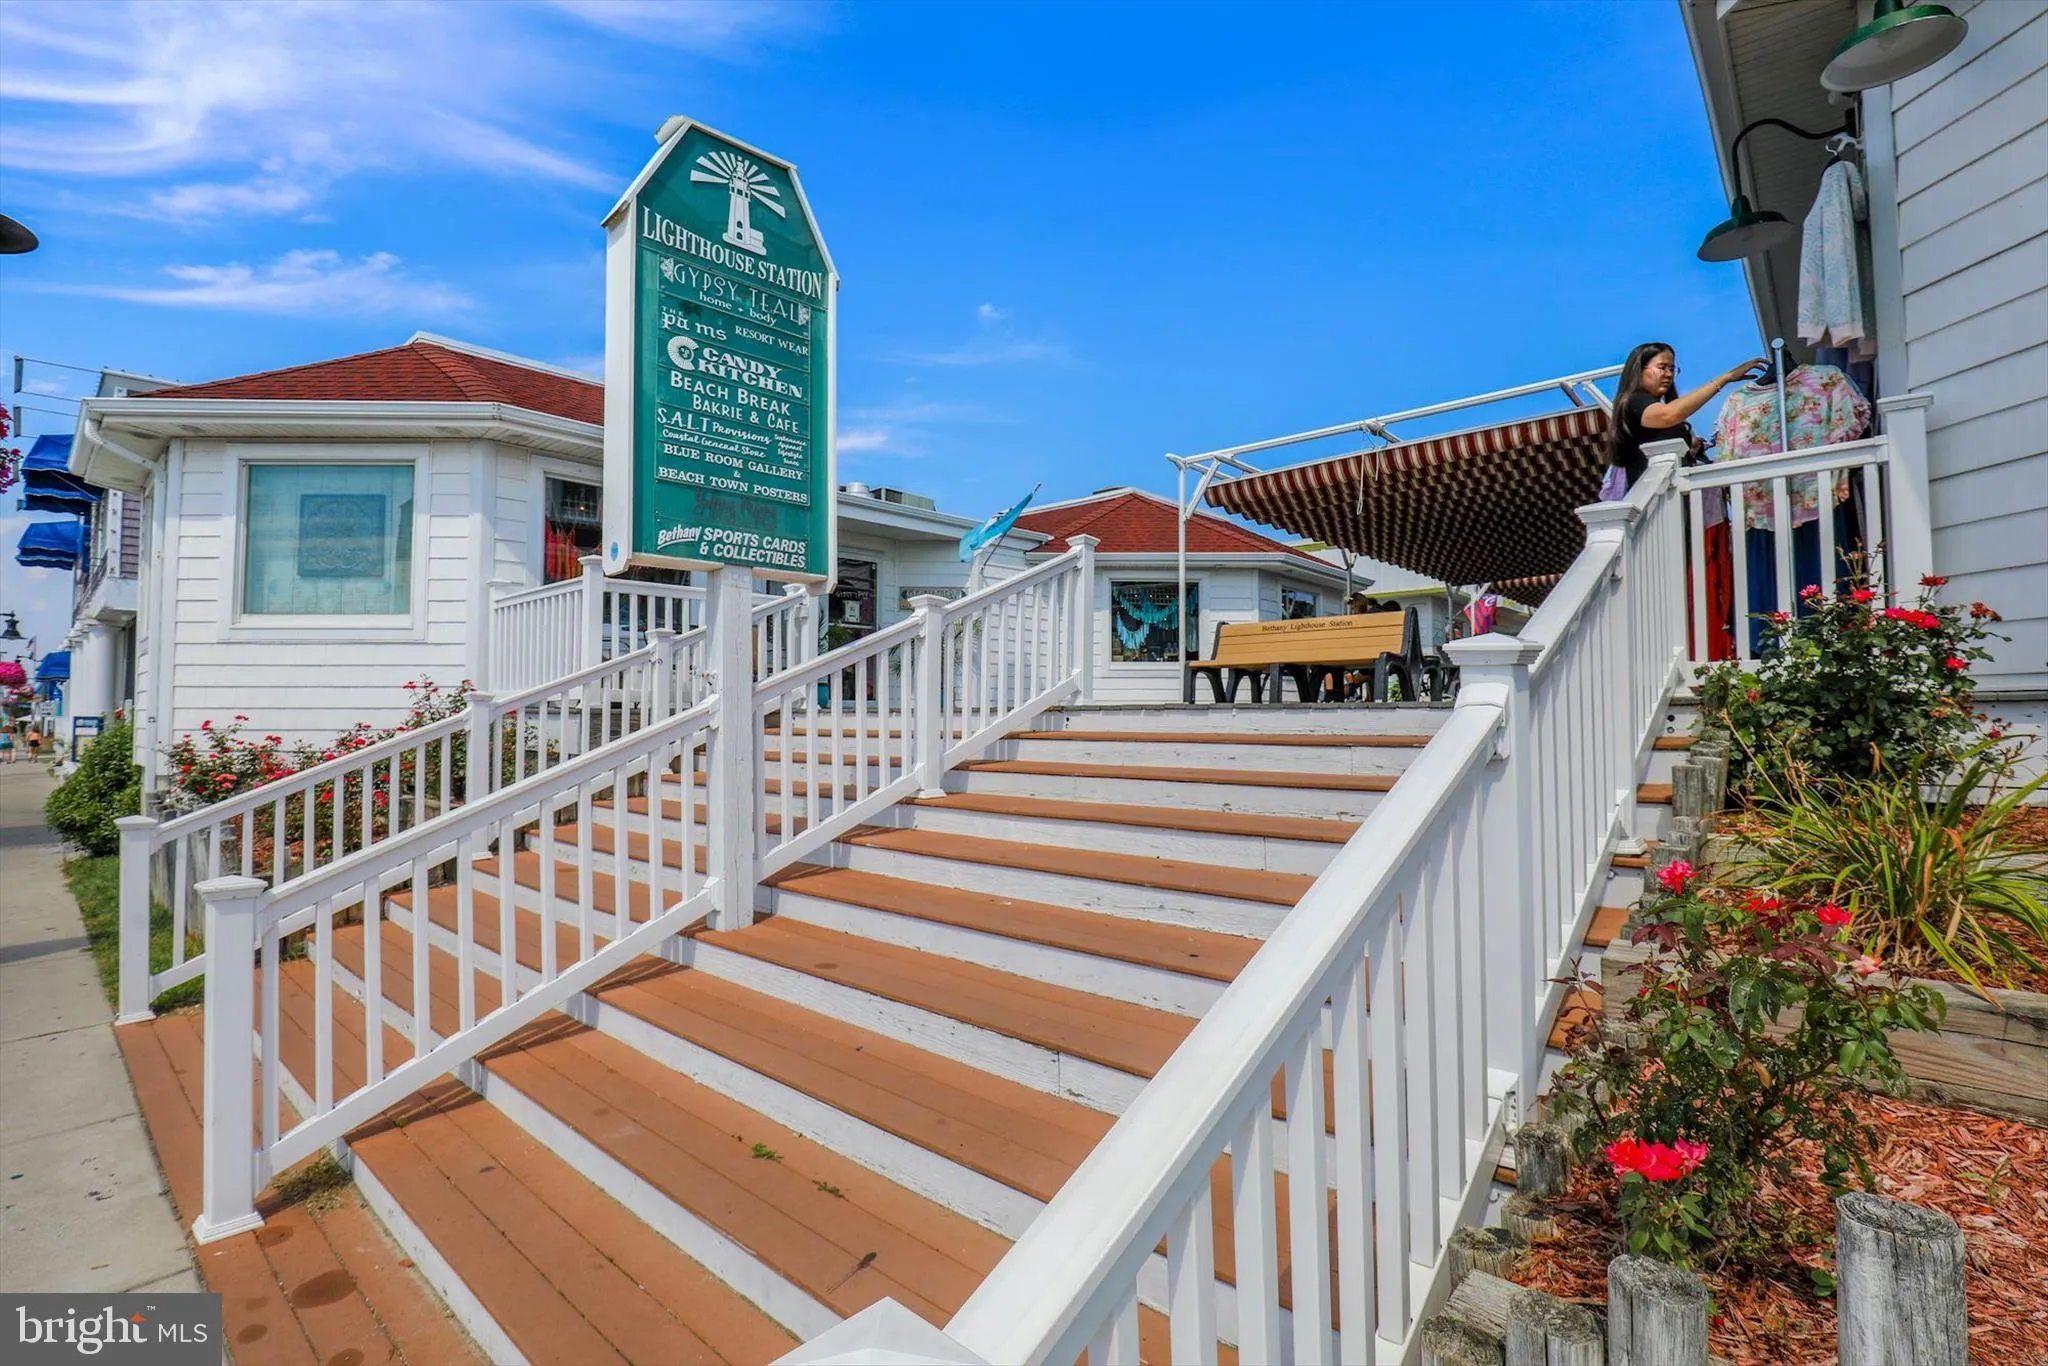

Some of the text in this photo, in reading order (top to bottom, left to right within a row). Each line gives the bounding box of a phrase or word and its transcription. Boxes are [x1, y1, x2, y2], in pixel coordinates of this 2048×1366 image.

[642, 206, 823, 299] LIGHTHOUSE STATION
[674, 263, 799, 323] GYPSY TEAL
[699, 292, 732, 310] home
[750, 308, 777, 327] body
[735, 325, 775, 345] RESORT
[777, 339, 809, 356] WEAR
[698, 358, 803, 399] KITCHEN
[702, 347, 783, 379] CANDY
[670, 370, 791, 416] BEACH BREAK
[693, 393, 799, 434] BAKRIE & CAFE
[662, 428, 767, 459] Coastal General Store
[663, 443, 804, 480] BLUE ROOM GALLERY
[733, 469, 741, 479] &
[658, 467, 808, 504] BEACH TOWN POSTERS
[657, 524, 806, 555] Bethany SPORTS CARDS
[699, 541, 806, 568] & COLLECTIBLES
[1262, 620, 1353, 632] Bethany Lighthouse Station
